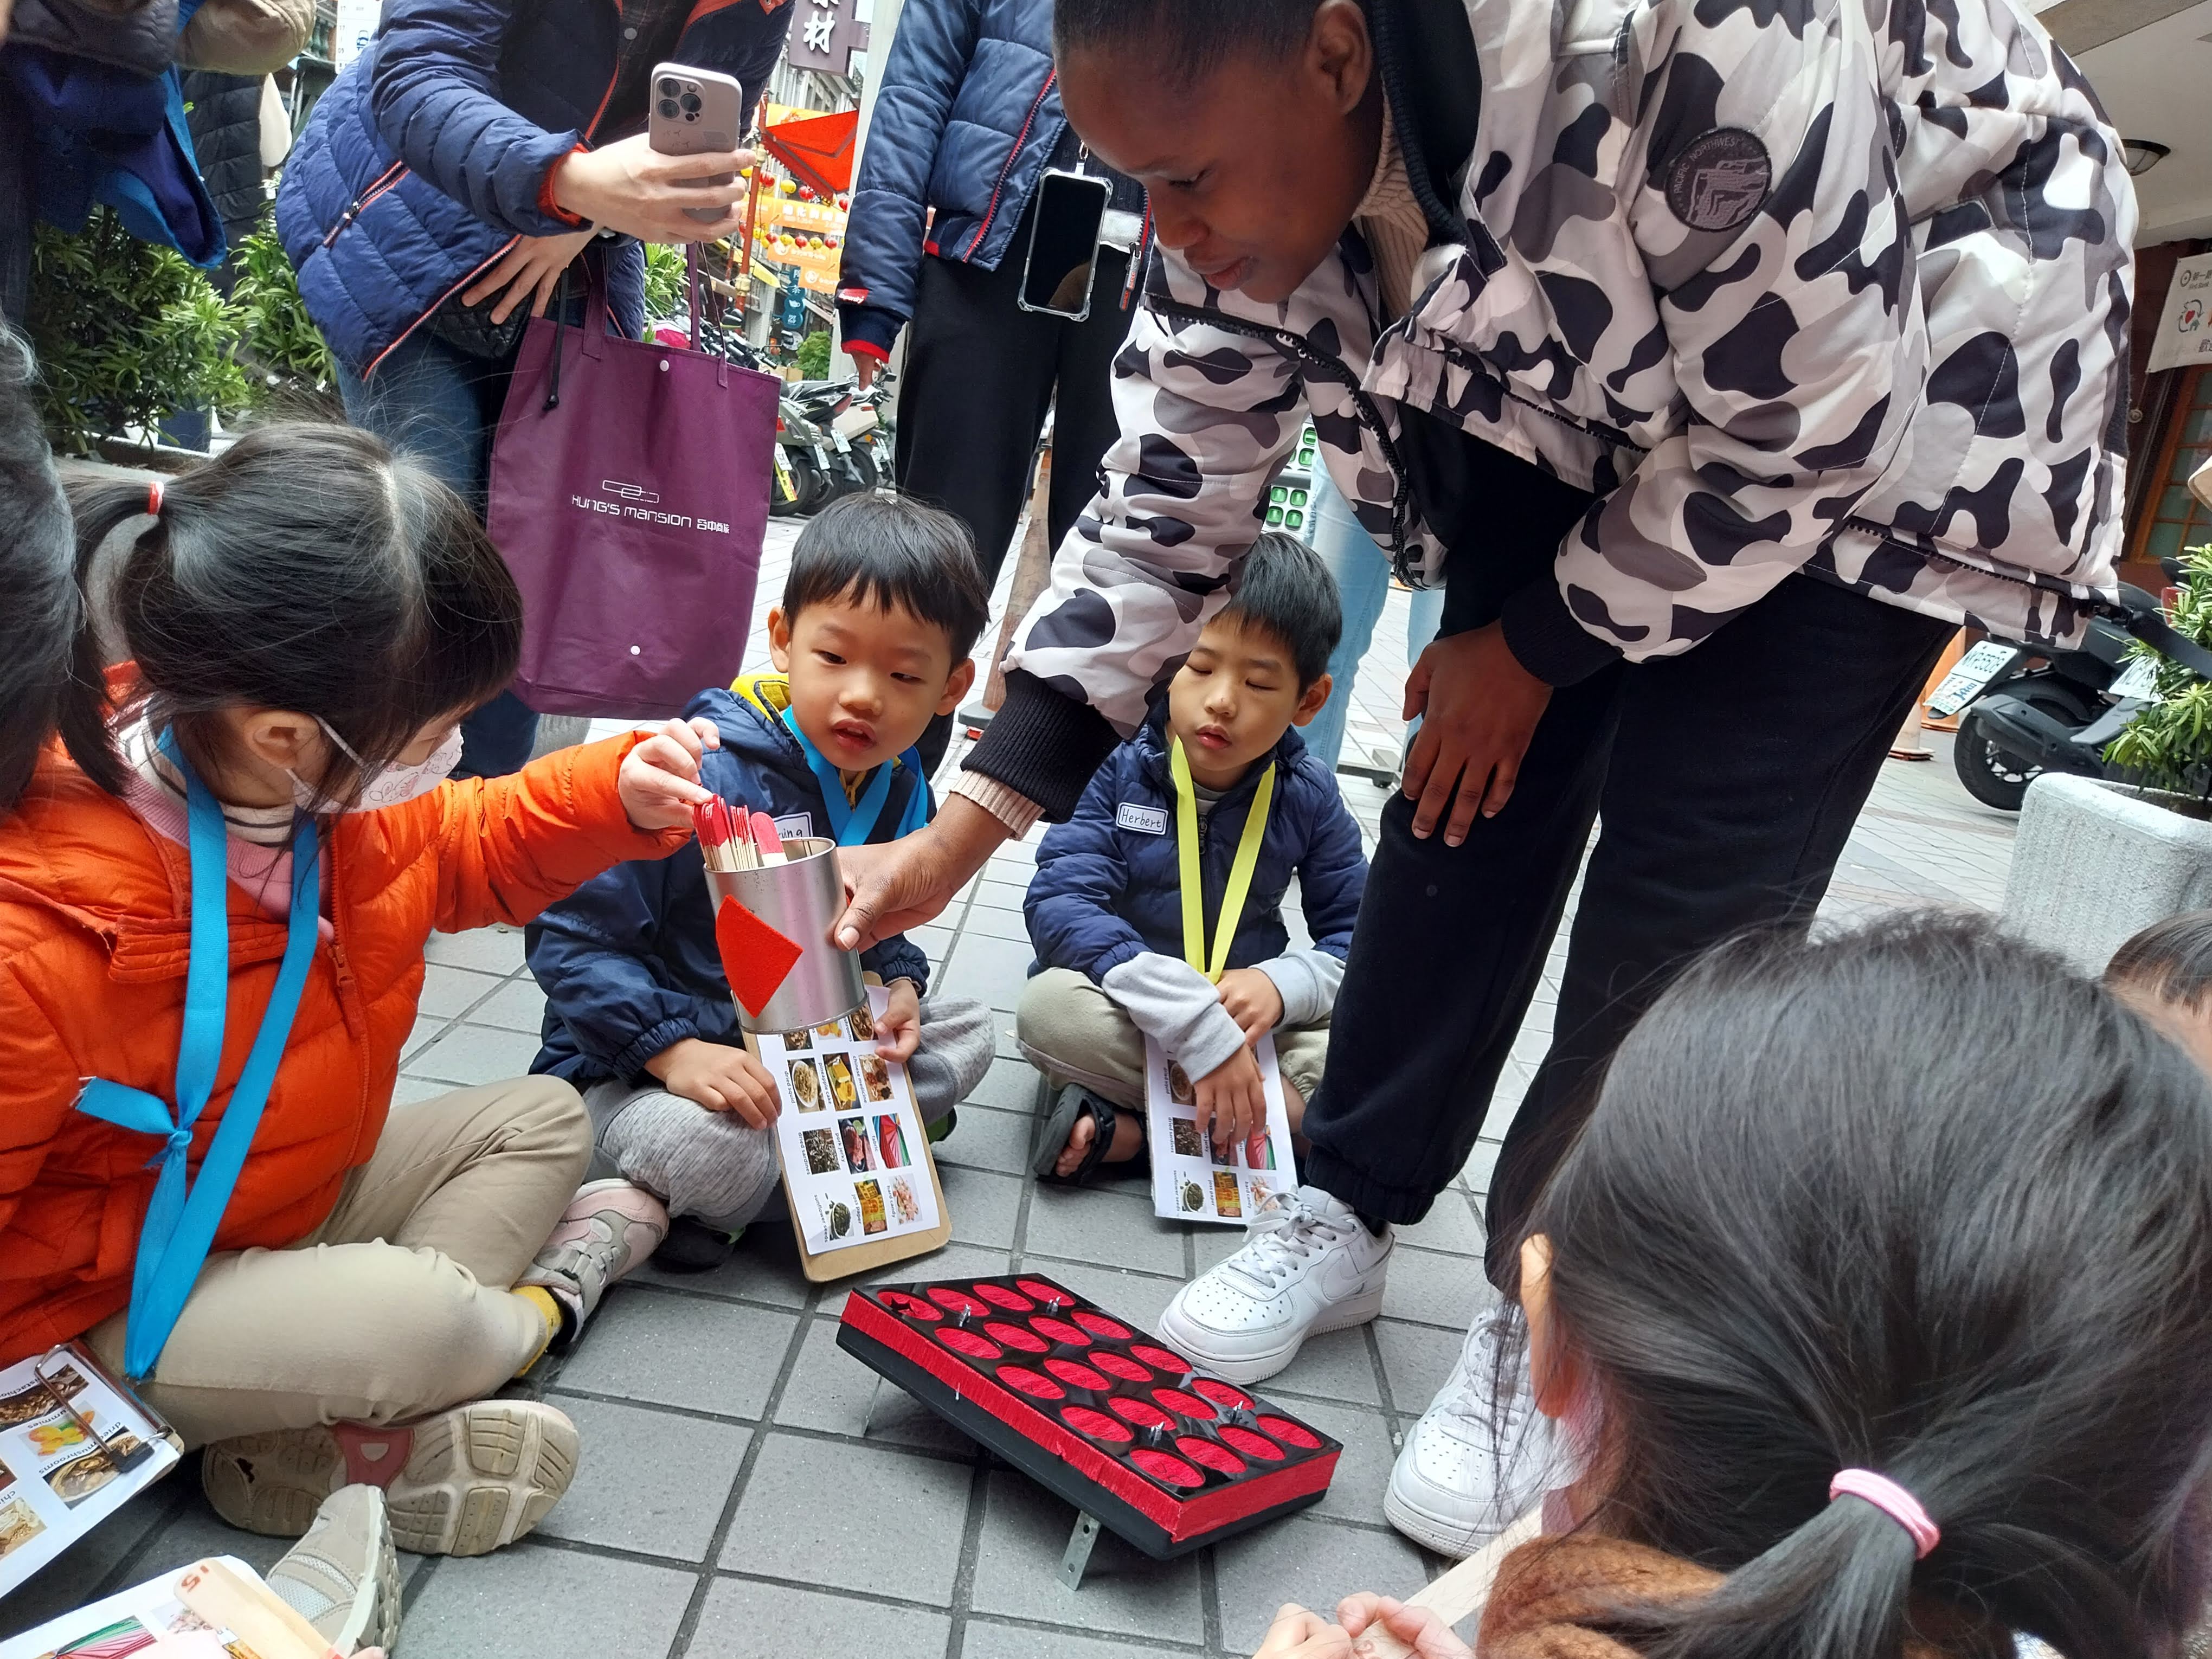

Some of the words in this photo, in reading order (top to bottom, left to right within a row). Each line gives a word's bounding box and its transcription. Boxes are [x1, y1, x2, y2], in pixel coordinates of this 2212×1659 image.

[1674, 163, 1690, 194] PACIFIC
[1689, 137, 1740, 161] NORTHWEST
[1121, 808, 1161, 828] Herbert
[818, 1062, 830, 1090] pineapple
[853, 1055, 861, 1077] chinese
[858, 1077, 867, 1103] medicine
[801, 1148, 811, 1175] sardines
[814, 1194, 826, 1224] sunflower
[27, 1409, 67, 1430] ummies
[38, 1441, 98, 1474] mushrooms
